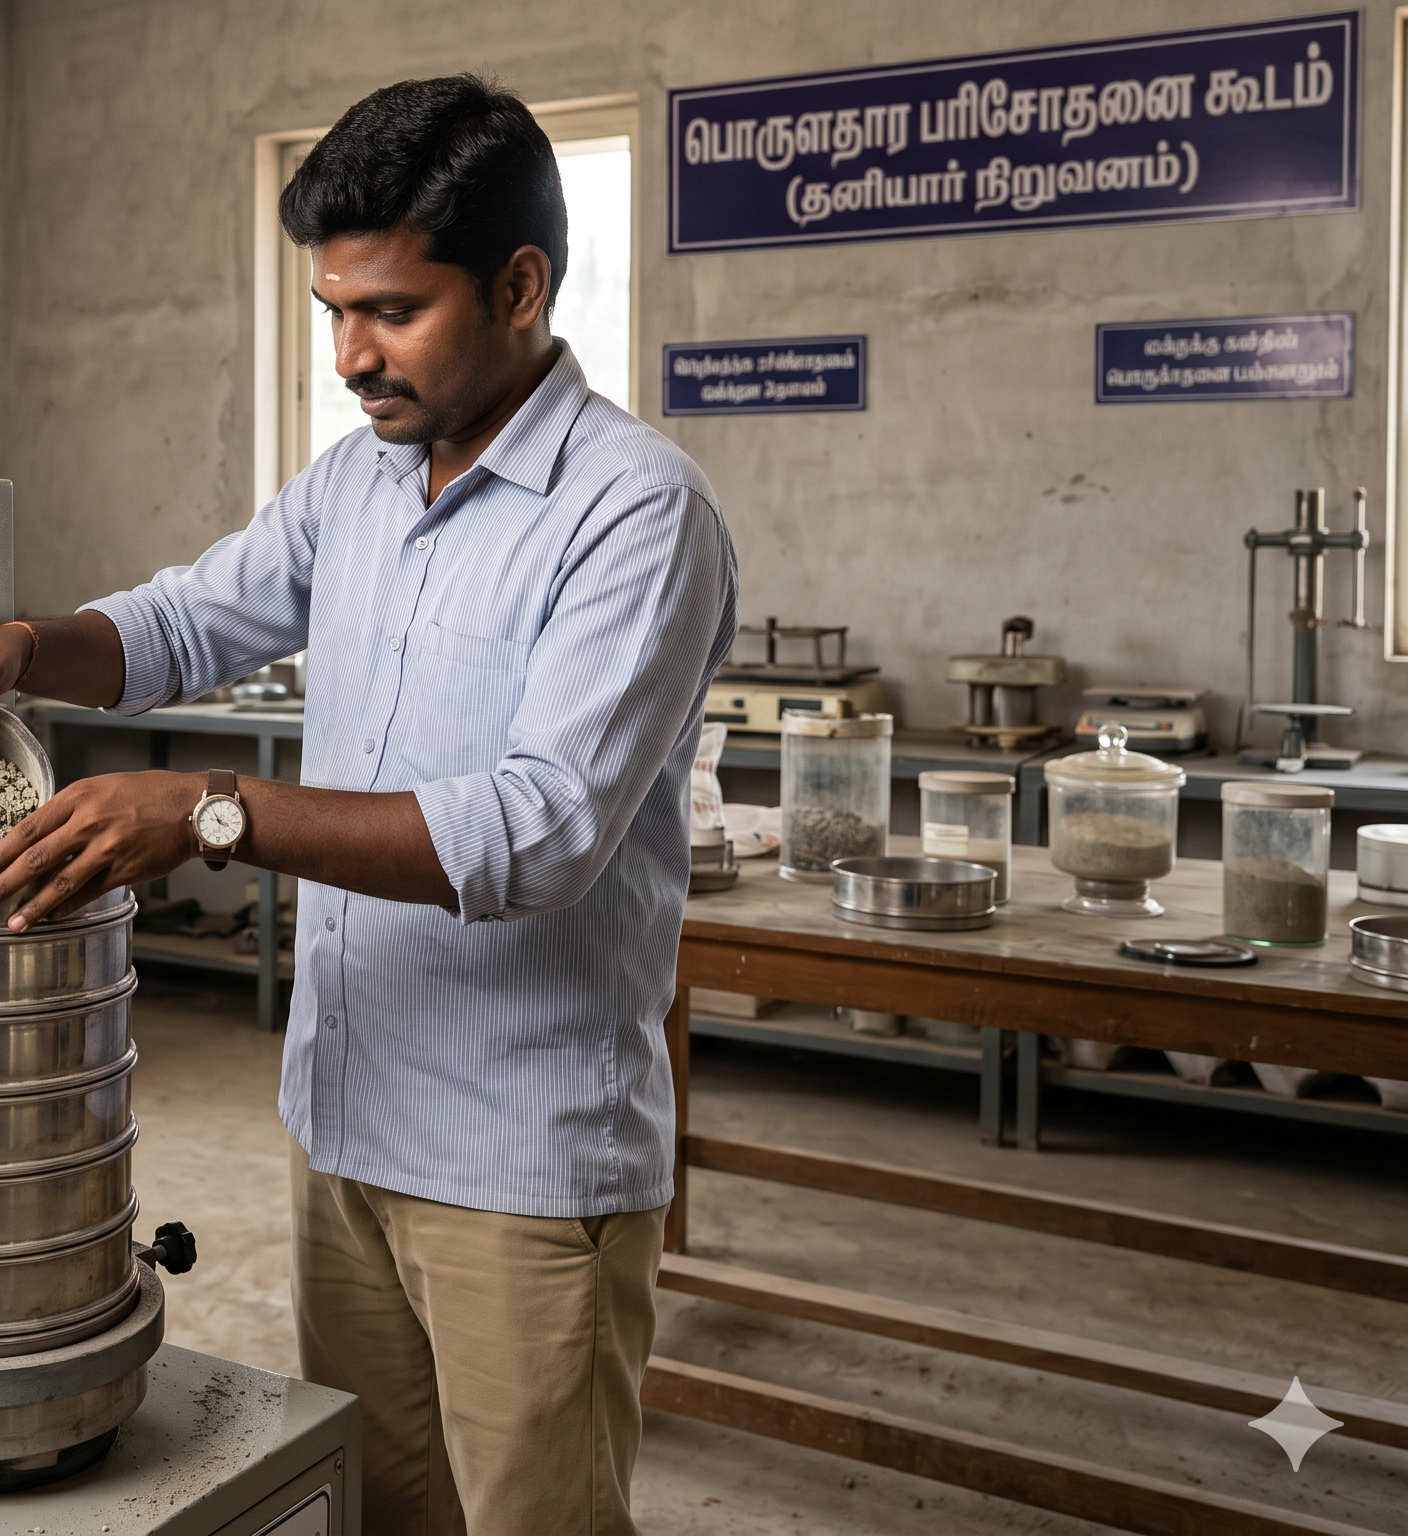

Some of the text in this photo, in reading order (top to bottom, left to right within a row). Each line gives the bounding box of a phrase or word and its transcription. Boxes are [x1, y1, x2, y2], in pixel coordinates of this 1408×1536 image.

[684, 41, 1334, 172] பொருளதார பரிசோதனை கூடம்
[785, 139, 1200, 229] (தனியார் நிறுவனம்)
